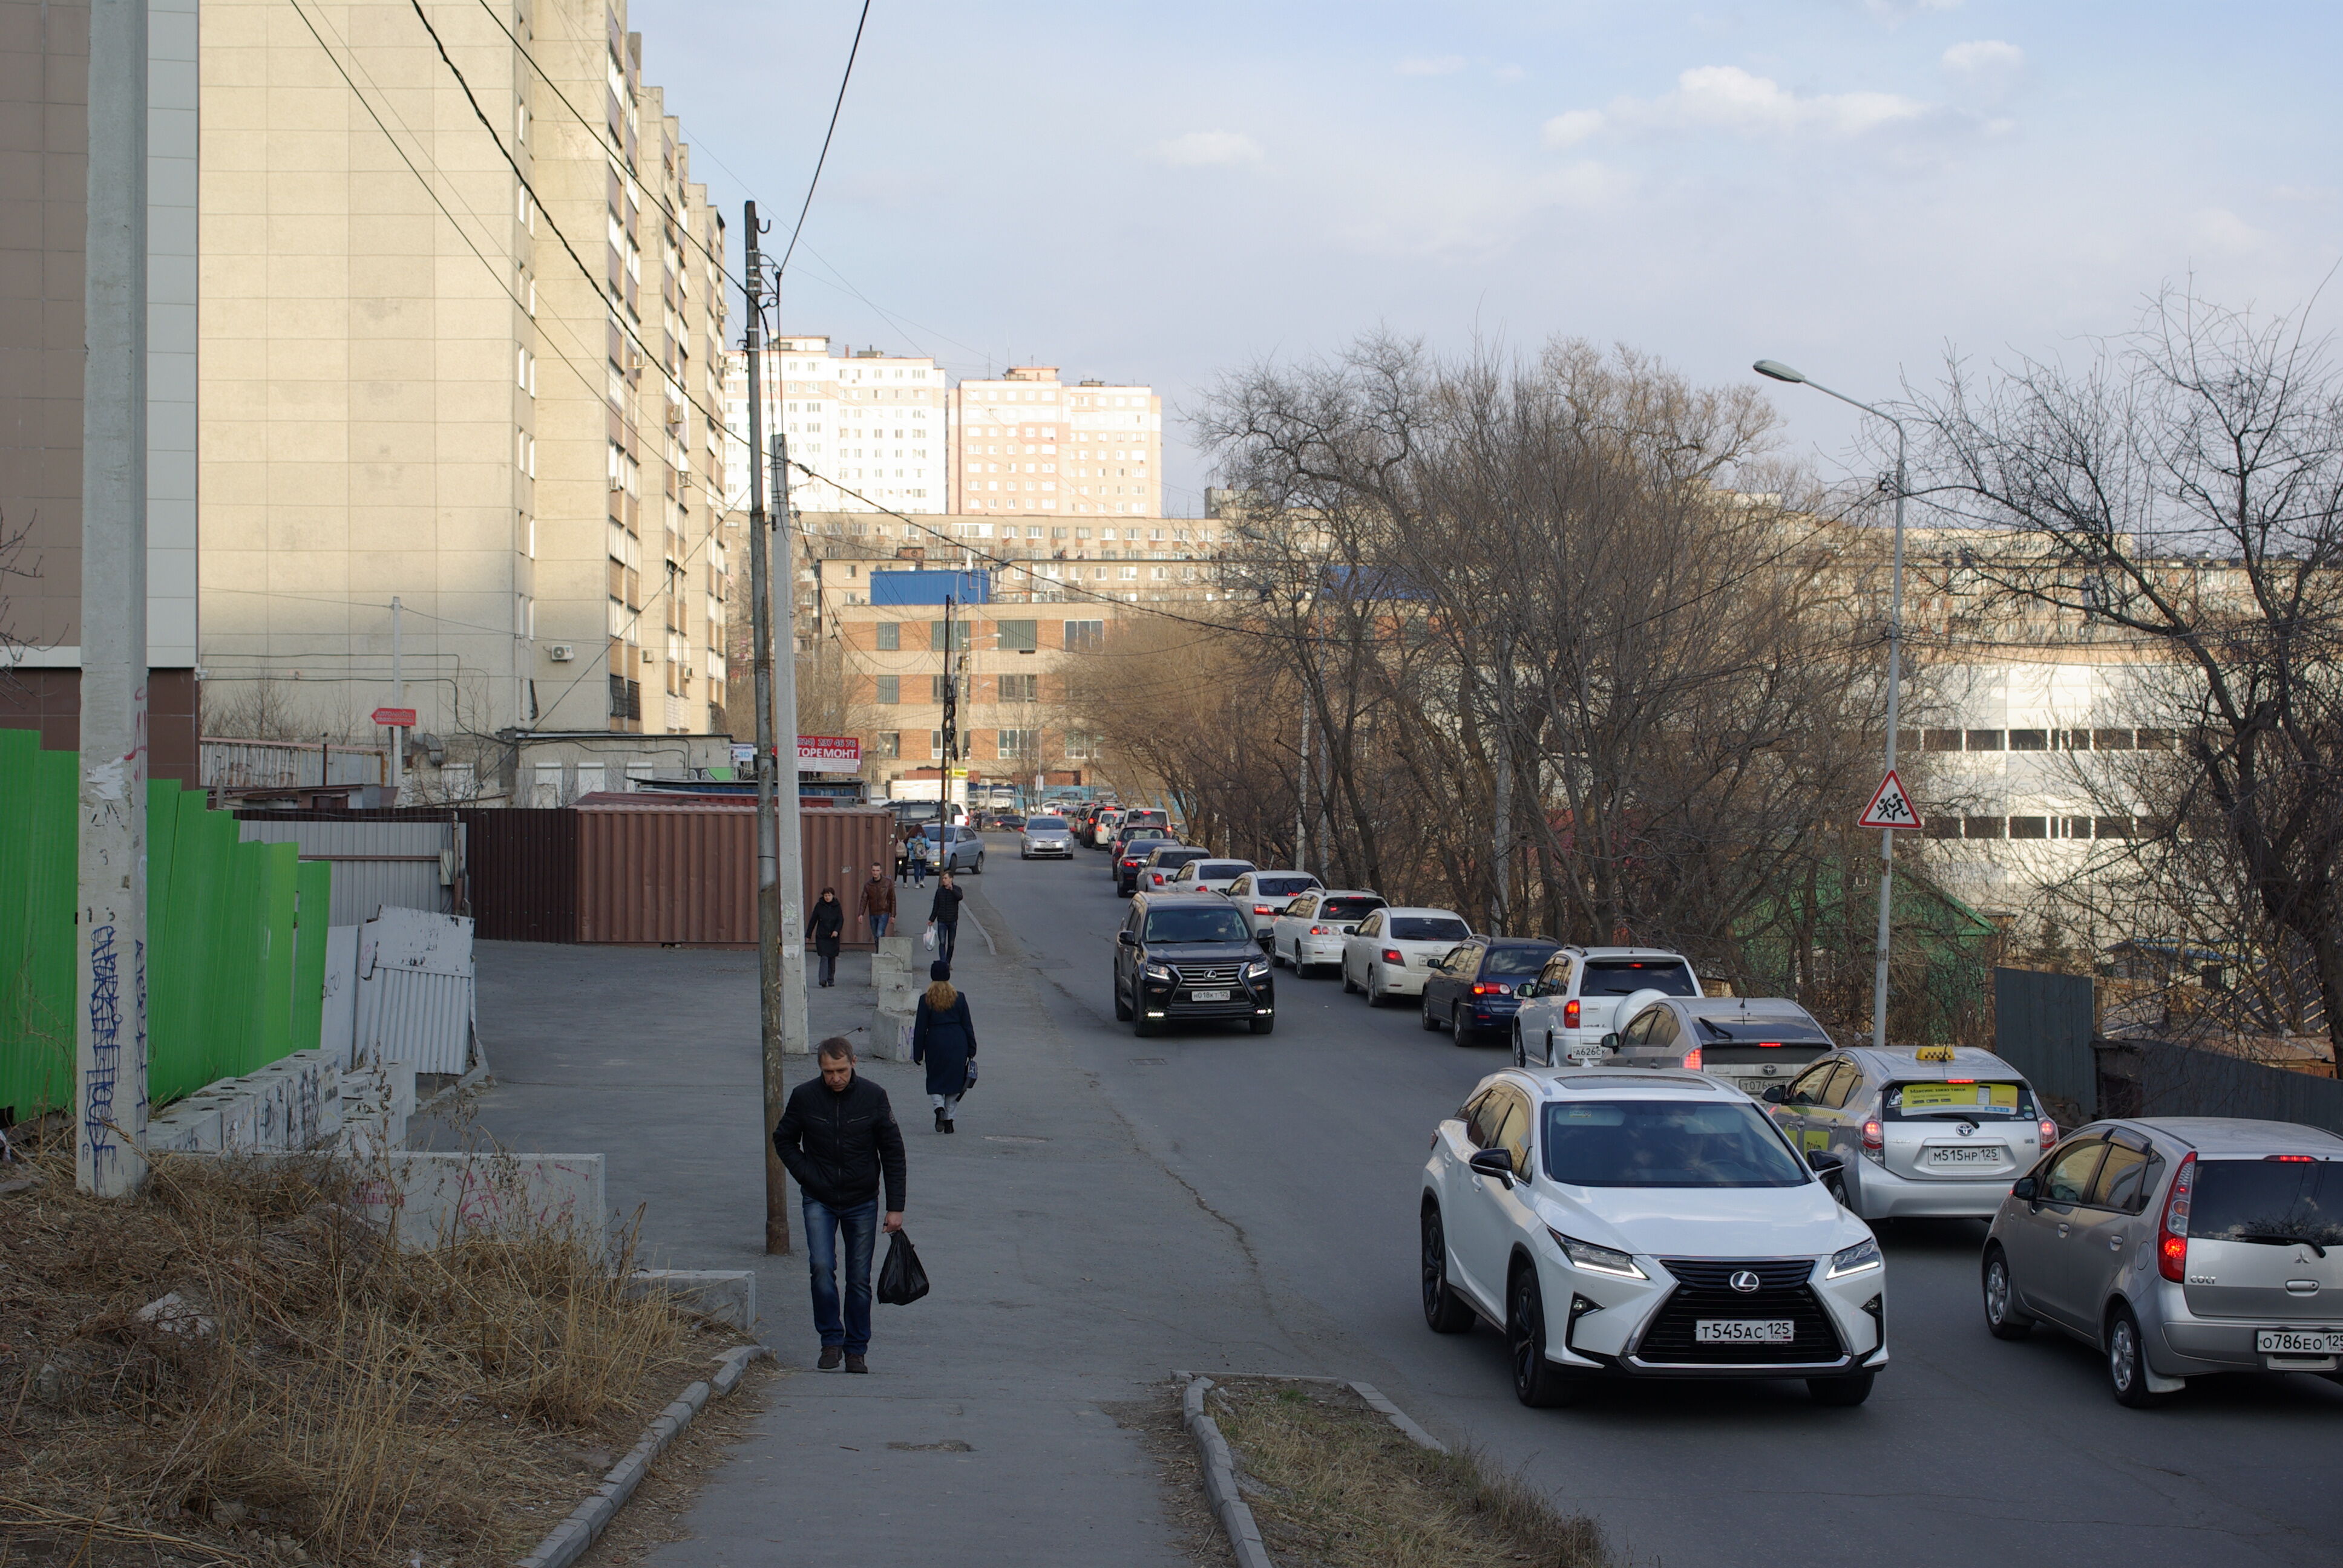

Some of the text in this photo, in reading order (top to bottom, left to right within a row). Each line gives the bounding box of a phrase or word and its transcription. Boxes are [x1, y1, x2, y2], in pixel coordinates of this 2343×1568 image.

[797, 748, 856, 759] ТОРЕМОНТ
[1934, 1150, 1978, 1161] М515НР
[2191, 1275, 2217, 1284] COLT
[1702, 1323, 1789, 1339] Т545АС 125
[2263, 1334, 2322, 1350] О786ЕО
